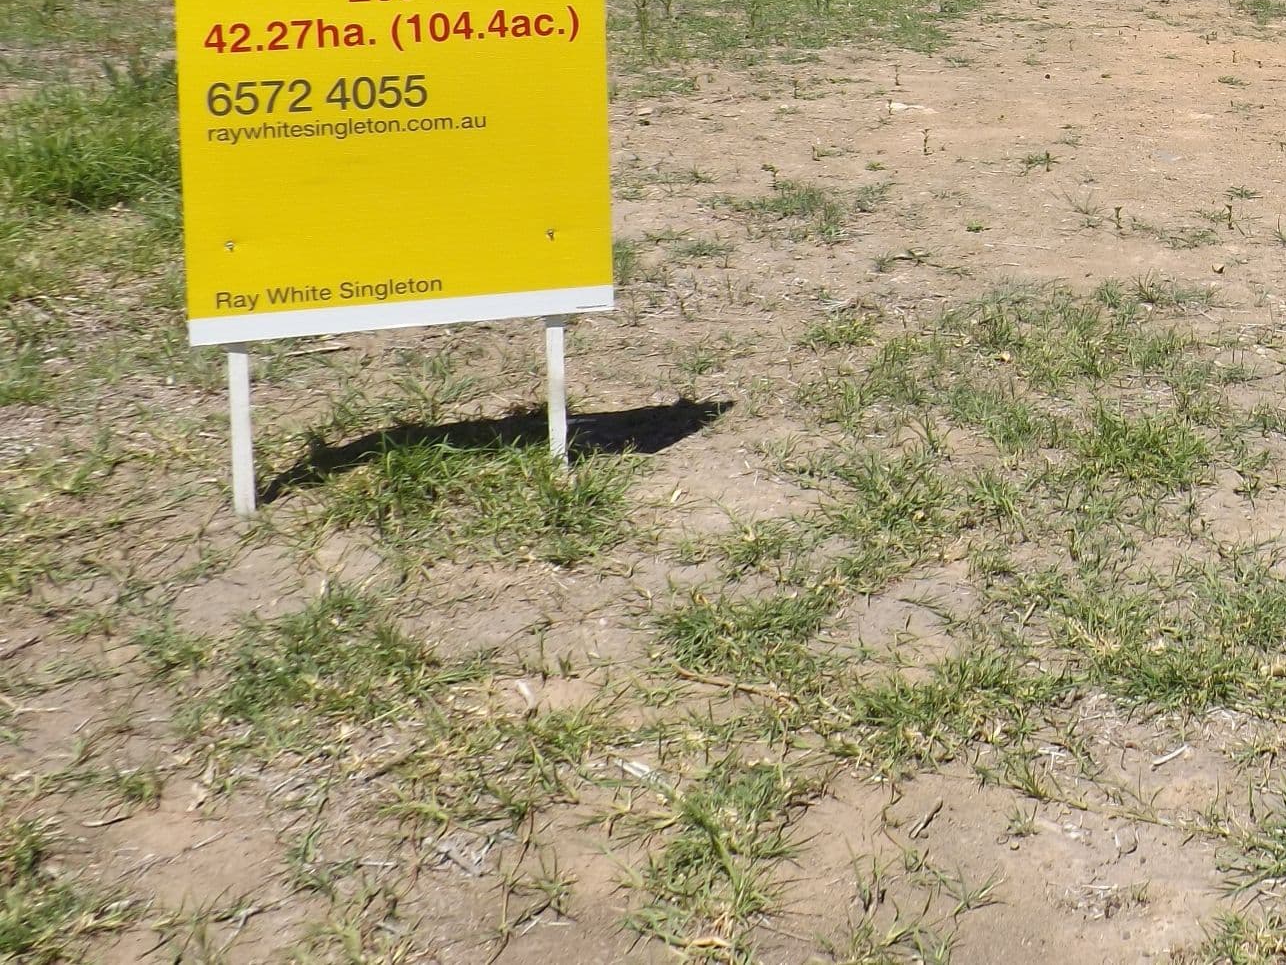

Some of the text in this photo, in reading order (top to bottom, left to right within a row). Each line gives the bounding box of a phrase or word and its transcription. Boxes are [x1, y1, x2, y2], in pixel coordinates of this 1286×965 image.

[204, 6, 580, 54] 42.27ha. (104.4ac.)
[207, 75, 428, 116] 6572 4055
[207, 113, 487, 143] raywhitesingleton.com.au
[216, 276, 443, 311] Ray White Singleton
